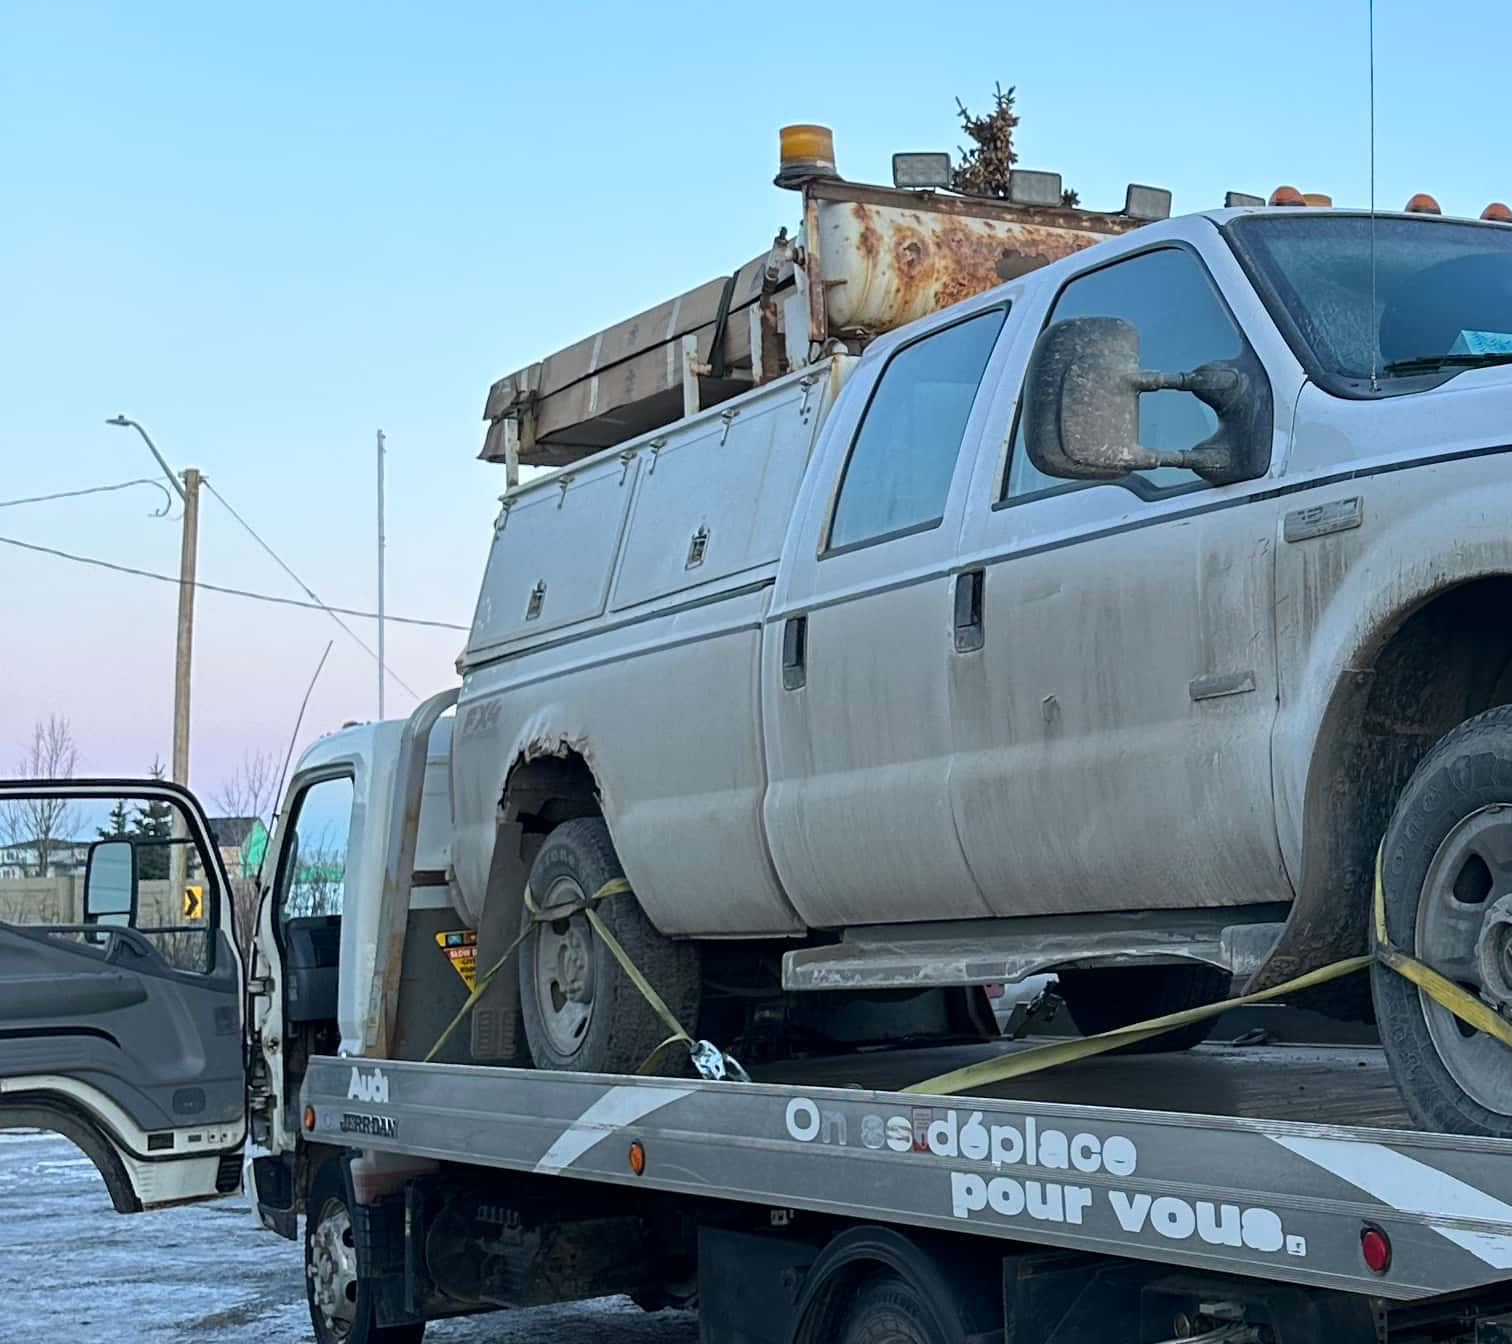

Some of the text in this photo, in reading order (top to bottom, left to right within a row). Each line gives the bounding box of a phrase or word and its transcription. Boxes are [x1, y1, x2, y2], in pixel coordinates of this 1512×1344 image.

[786, 1097, 848, 1146] On
[927, 1110, 1137, 1176] déplace
[950, 1171, 1092, 1225] pour
